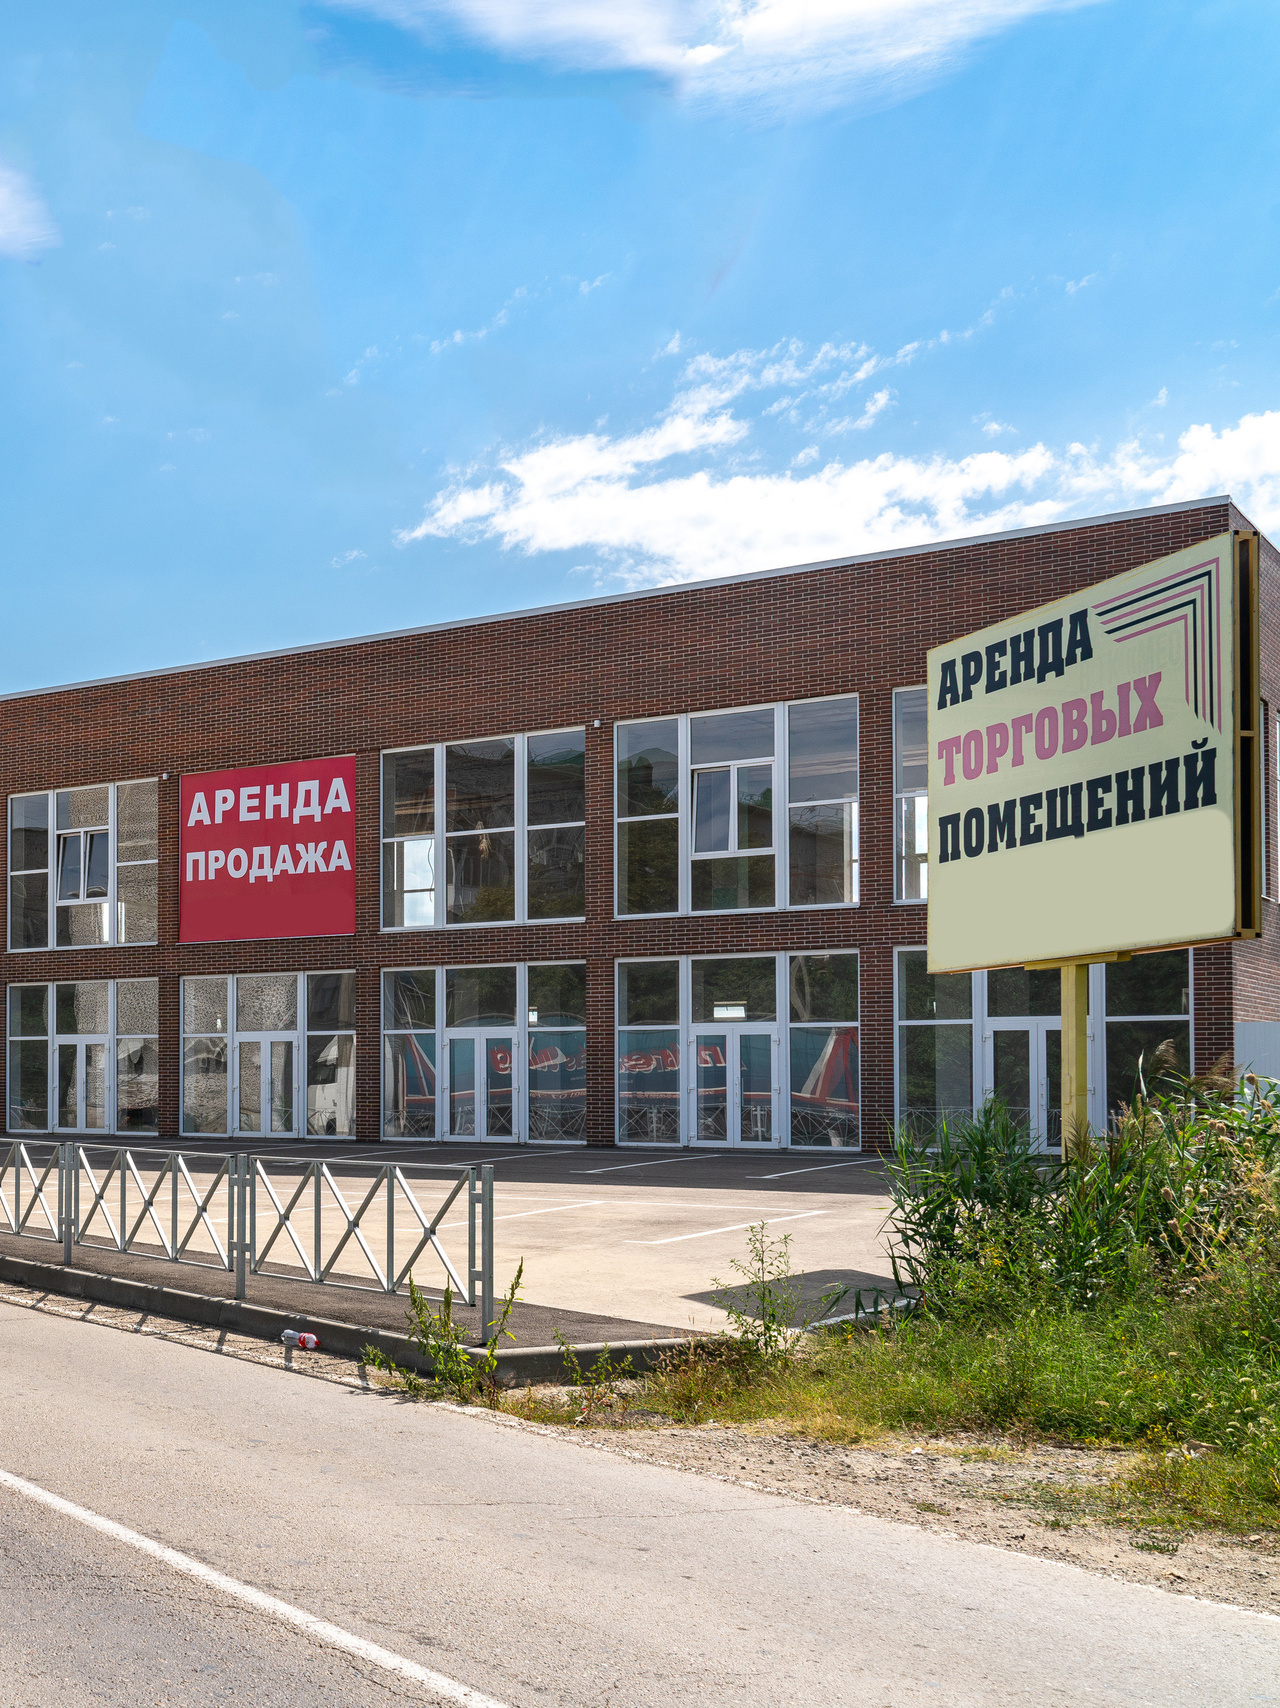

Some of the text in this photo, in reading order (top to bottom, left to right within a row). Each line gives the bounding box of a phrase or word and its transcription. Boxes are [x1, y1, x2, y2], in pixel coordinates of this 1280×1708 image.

[937, 607, 1094, 711] АРЕНДА
[937, 670, 1164, 787] ТОРГОВЫХ
[187, 777, 351, 827] АРЕНДА
[938, 736, 1217, 864] ПОМЕЩЕНИЙ
[186, 840, 352, 884] ПРОДАЖА
